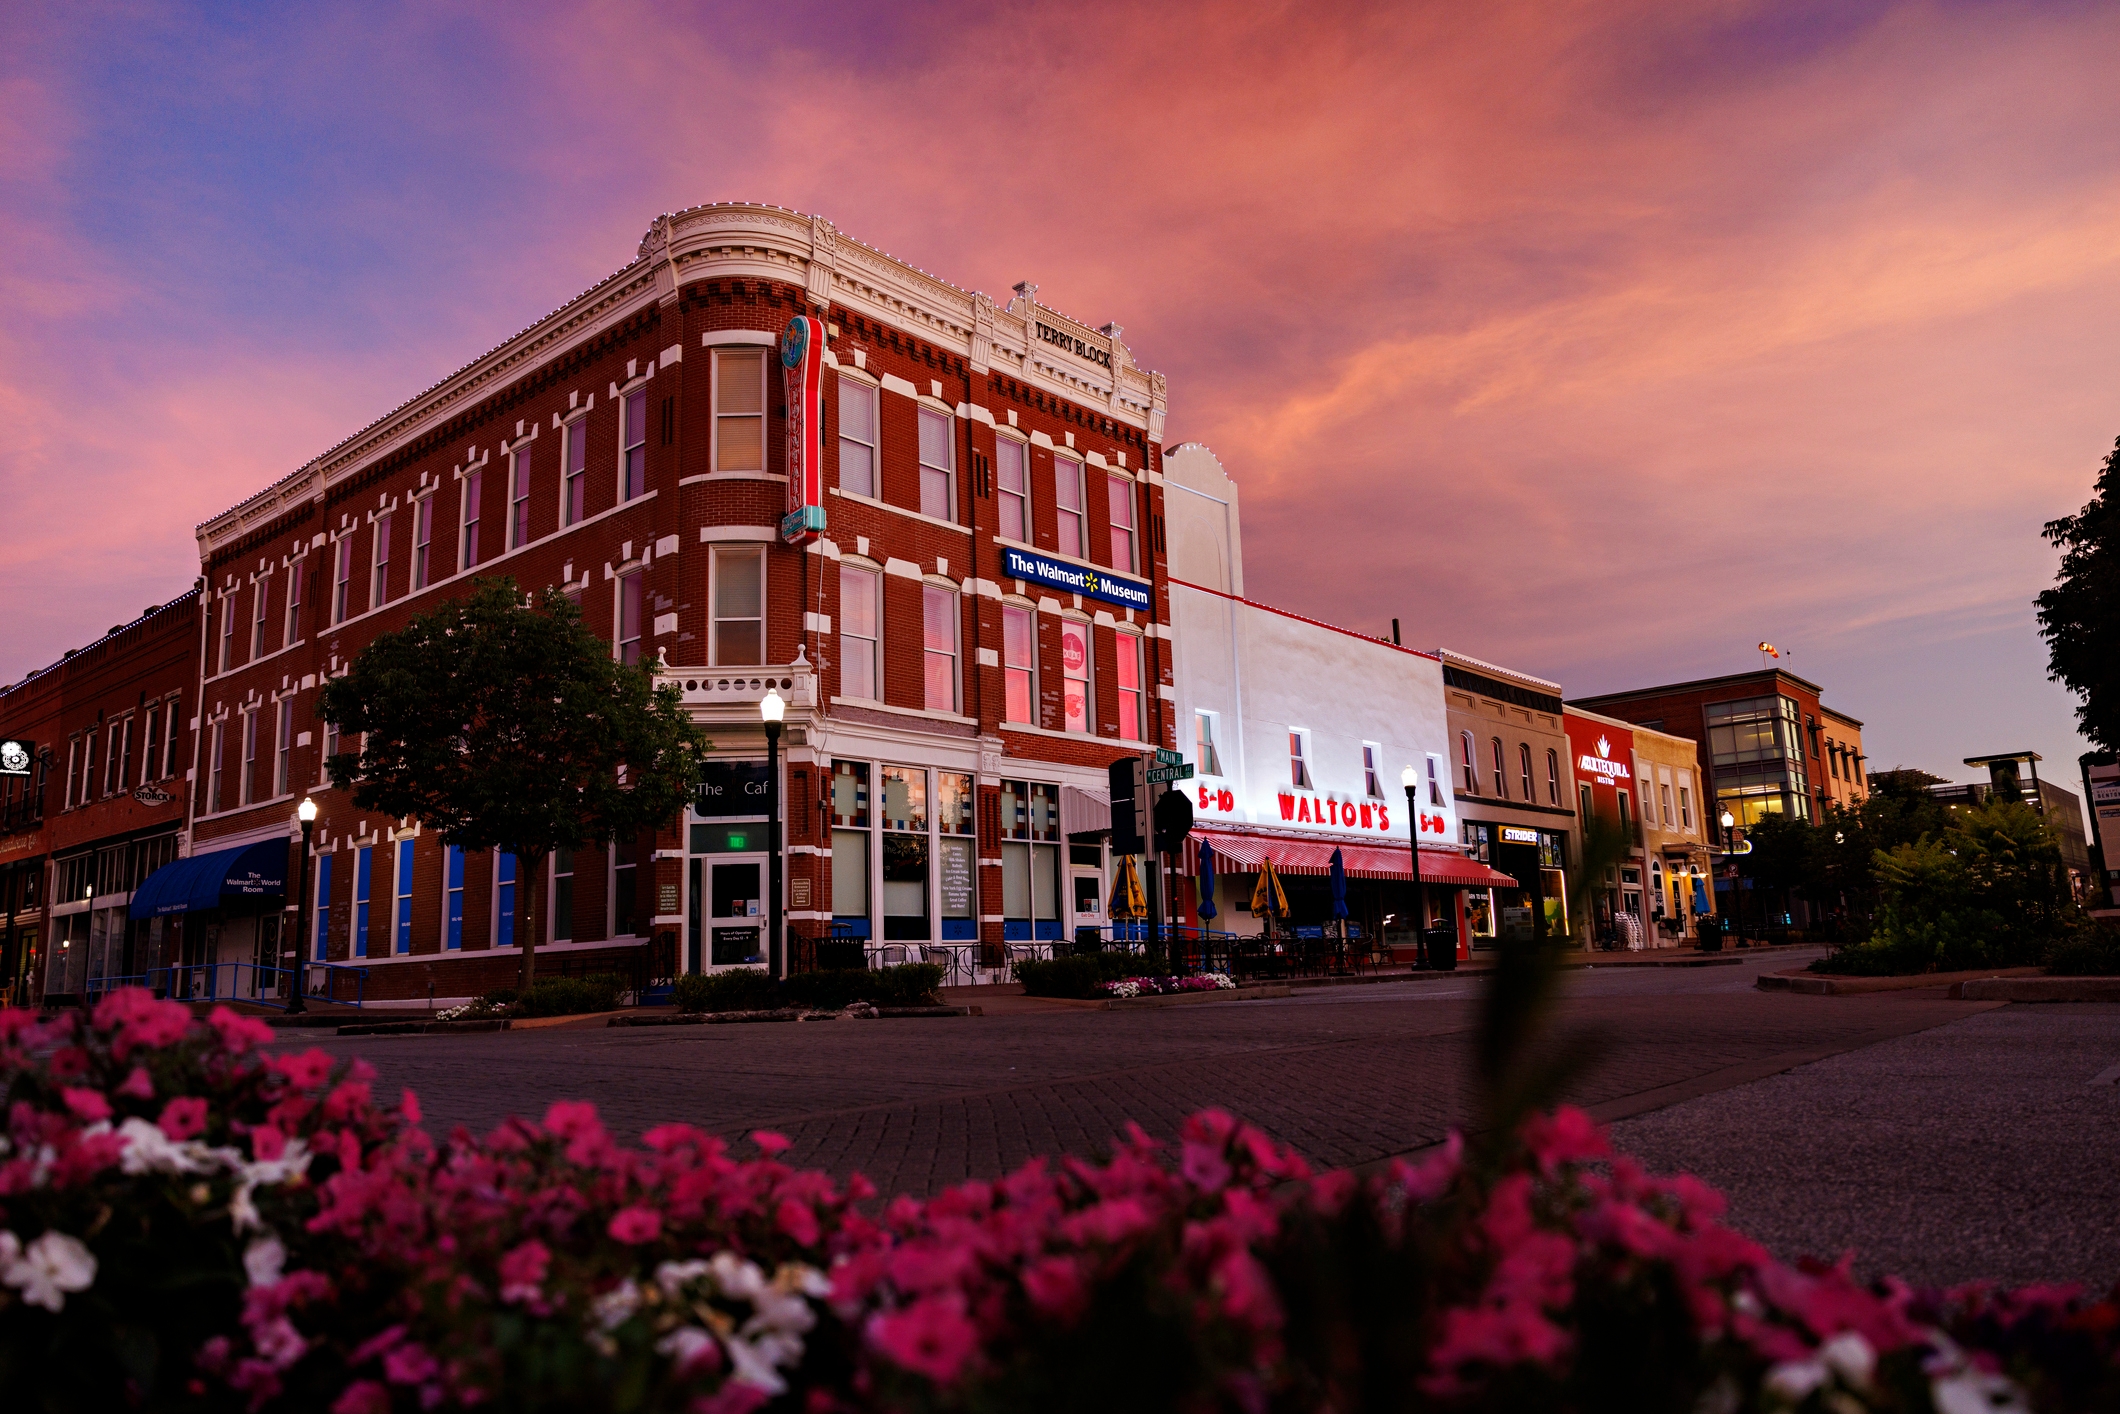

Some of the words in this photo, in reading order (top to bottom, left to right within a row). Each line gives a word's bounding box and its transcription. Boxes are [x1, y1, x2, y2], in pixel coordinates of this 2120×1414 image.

[1036, 321, 1073, 352] TERRY
[1075, 339, 1111, 369] BLOCK
[790, 390, 800, 510] FOUNTAIN
[1009, 553, 1034, 574] The
[1036, 561, 1085, 587] Walmart
[1101, 578, 1148, 604] Museum
[1160, 750, 1176, 764] MAIN
[1152, 766, 1184, 782] CENTRAL
[1597, 776, 1615, 786] BISTRO
[135, 791, 168, 801] STORCK
[696, 782, 723, 795] The
[744, 781, 768, 795] Caf
[1198, 787, 1234, 812] 5-10
[1278, 793, 1390, 831] WALTON'S
[1420, 813, 1446, 834] 5-10
[1505, 829, 1538, 842] STRIDER
